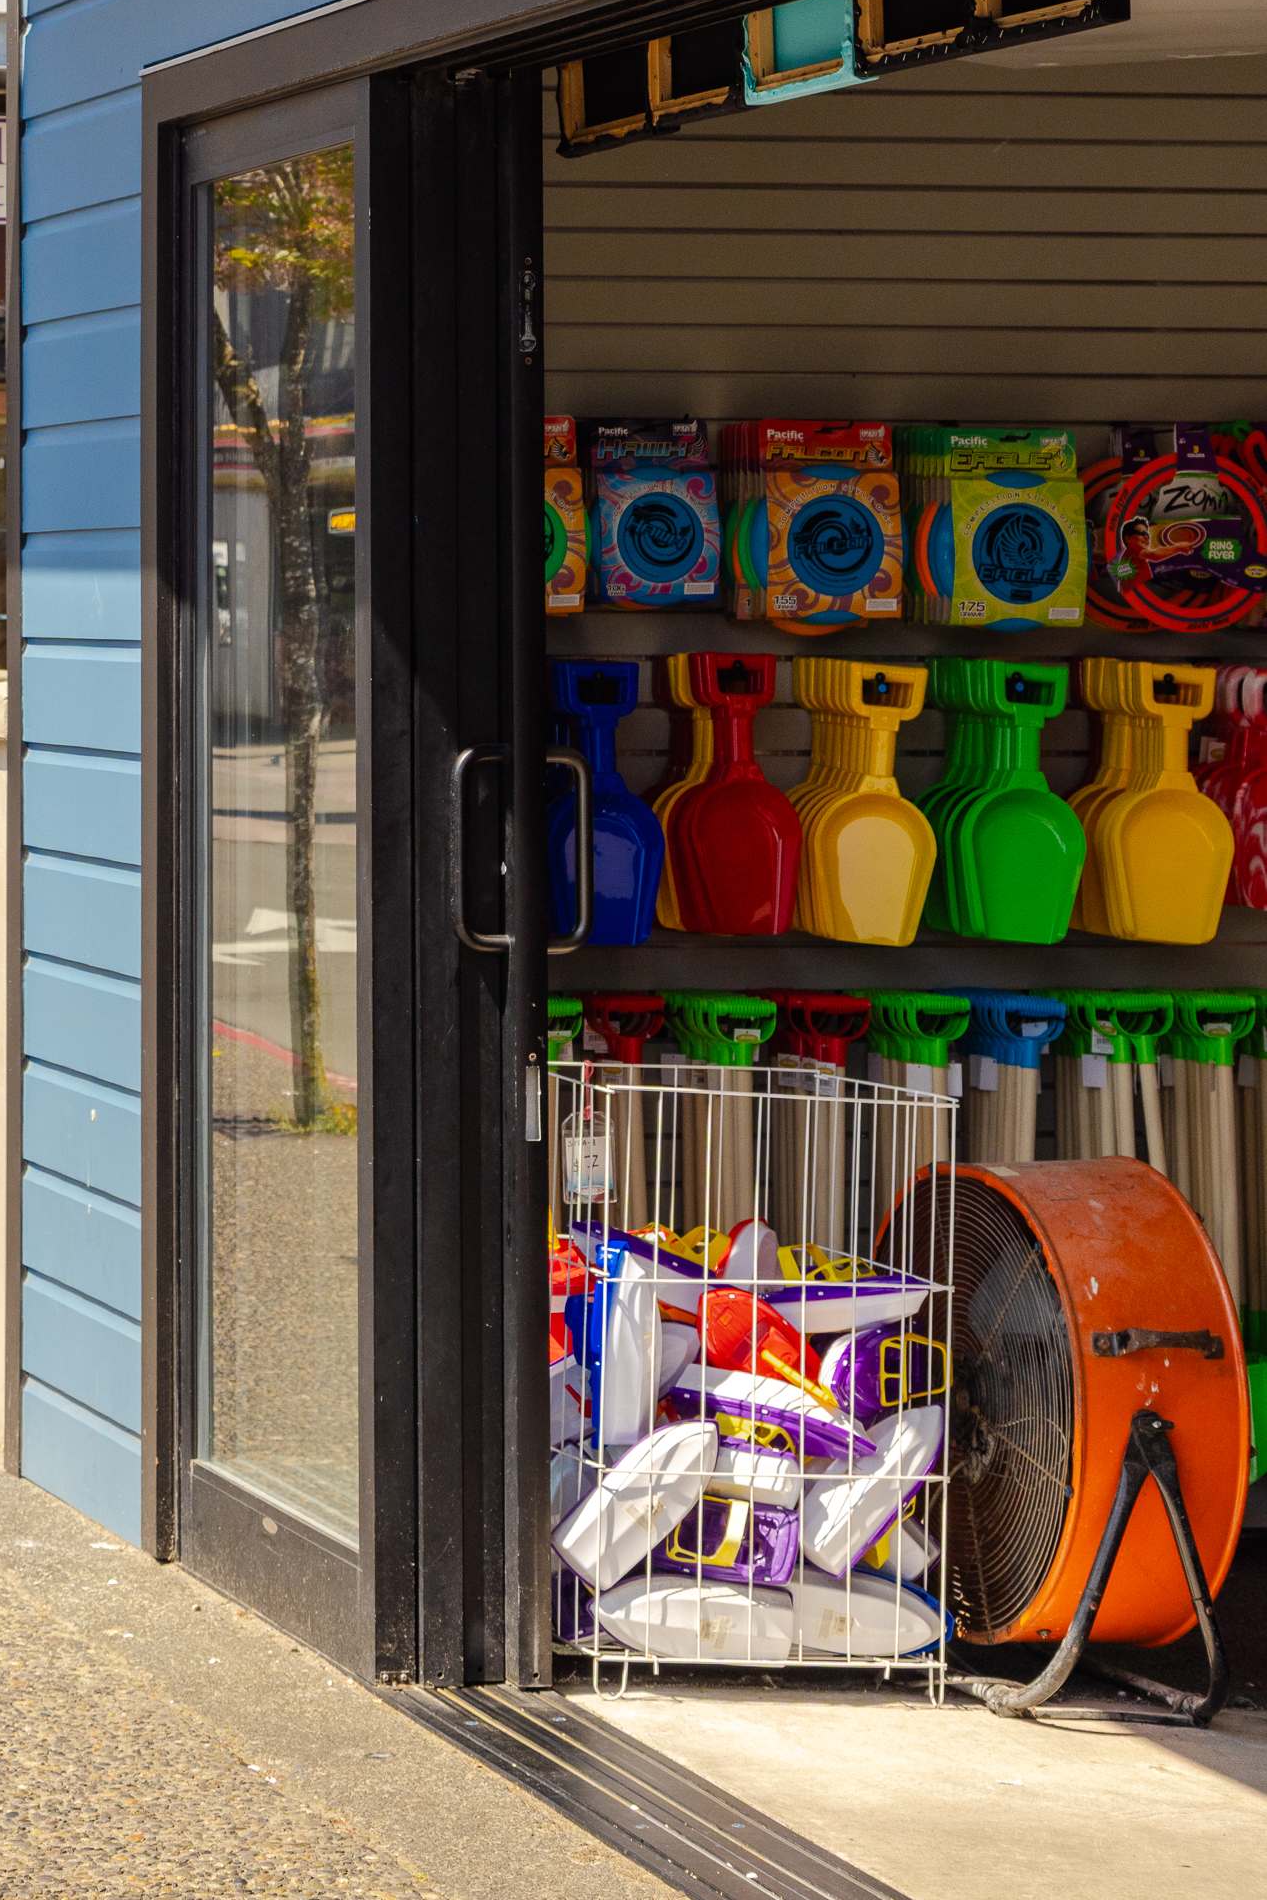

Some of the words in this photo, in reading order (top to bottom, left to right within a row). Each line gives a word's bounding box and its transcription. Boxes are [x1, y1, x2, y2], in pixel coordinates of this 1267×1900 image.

[598, 425, 629, 437] Pacific
[766, 428, 805, 441] Pacific
[950, 435, 988, 446] Pacific
[949, 448, 1054, 472] EAGLE
[1209, 541, 1234, 551] RING
[1208, 550, 1235, 560] FLYER
[978, 563, 1061, 584] EAGLE
[958, 601, 985, 612] 175
